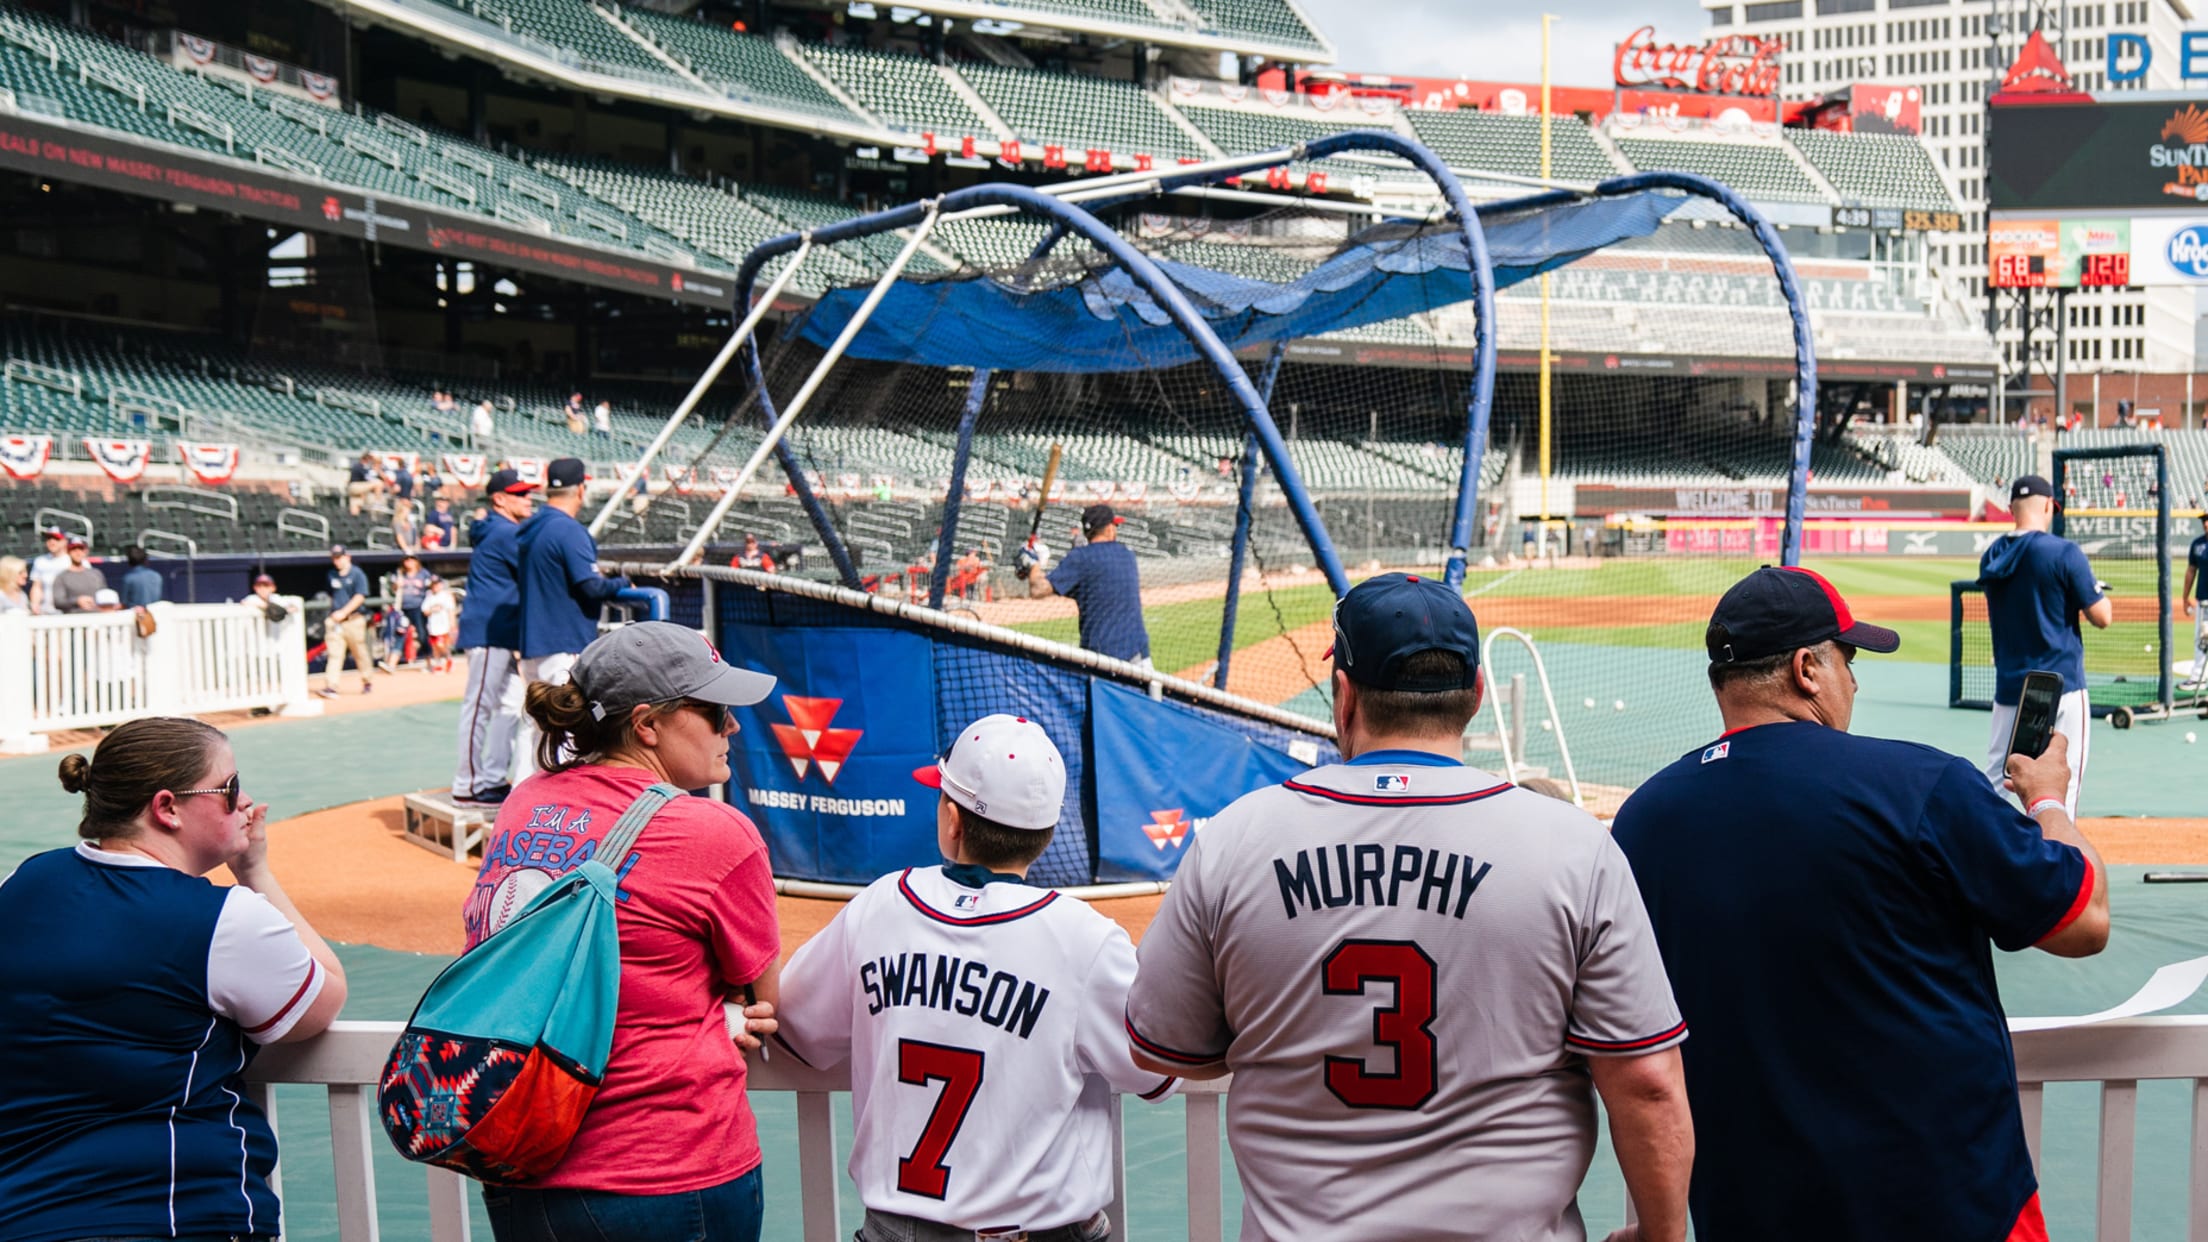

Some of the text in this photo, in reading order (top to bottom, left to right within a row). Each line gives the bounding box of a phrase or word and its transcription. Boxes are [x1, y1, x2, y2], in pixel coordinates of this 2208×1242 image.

[42, 141, 66, 161] ON
[68, 146, 103, 169] NEW
[1001, 140, 1022, 164] 10
[1999, 255, 2029, 275] 68
[2089, 255, 2128, 274] 120
[1676, 487, 1773, 511] WELCOME TO
[748, 788, 905, 816] MASSEY FERGUSON
[566, 809, 592, 834] A
[480, 830, 641, 904] ASEBAL
[1273, 844, 1493, 920] MURPHY
[860, 953, 1050, 1040] SWANSON
[1321, 938, 1438, 1111] 3
[897, 1037, 985, 1201] 7
